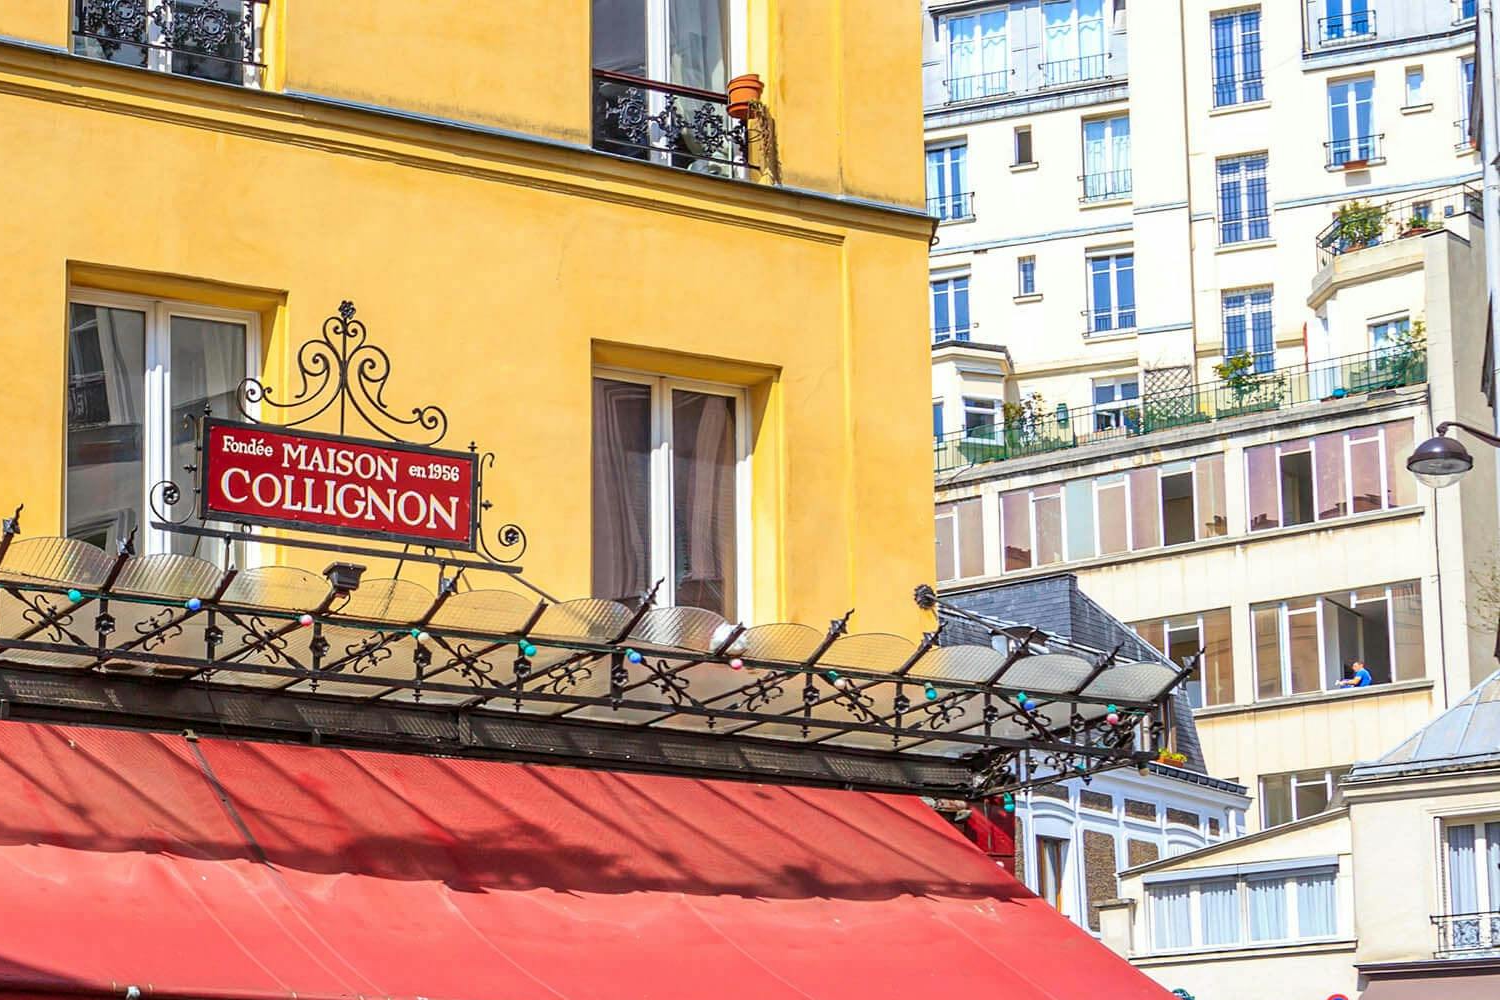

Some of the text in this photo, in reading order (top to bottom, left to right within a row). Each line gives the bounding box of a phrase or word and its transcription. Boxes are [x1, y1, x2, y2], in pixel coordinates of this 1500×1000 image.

[222, 435, 273, 456] Fondée
[281, 442, 398, 482] MAISON
[221, 467, 459, 530] COLLIGNON
